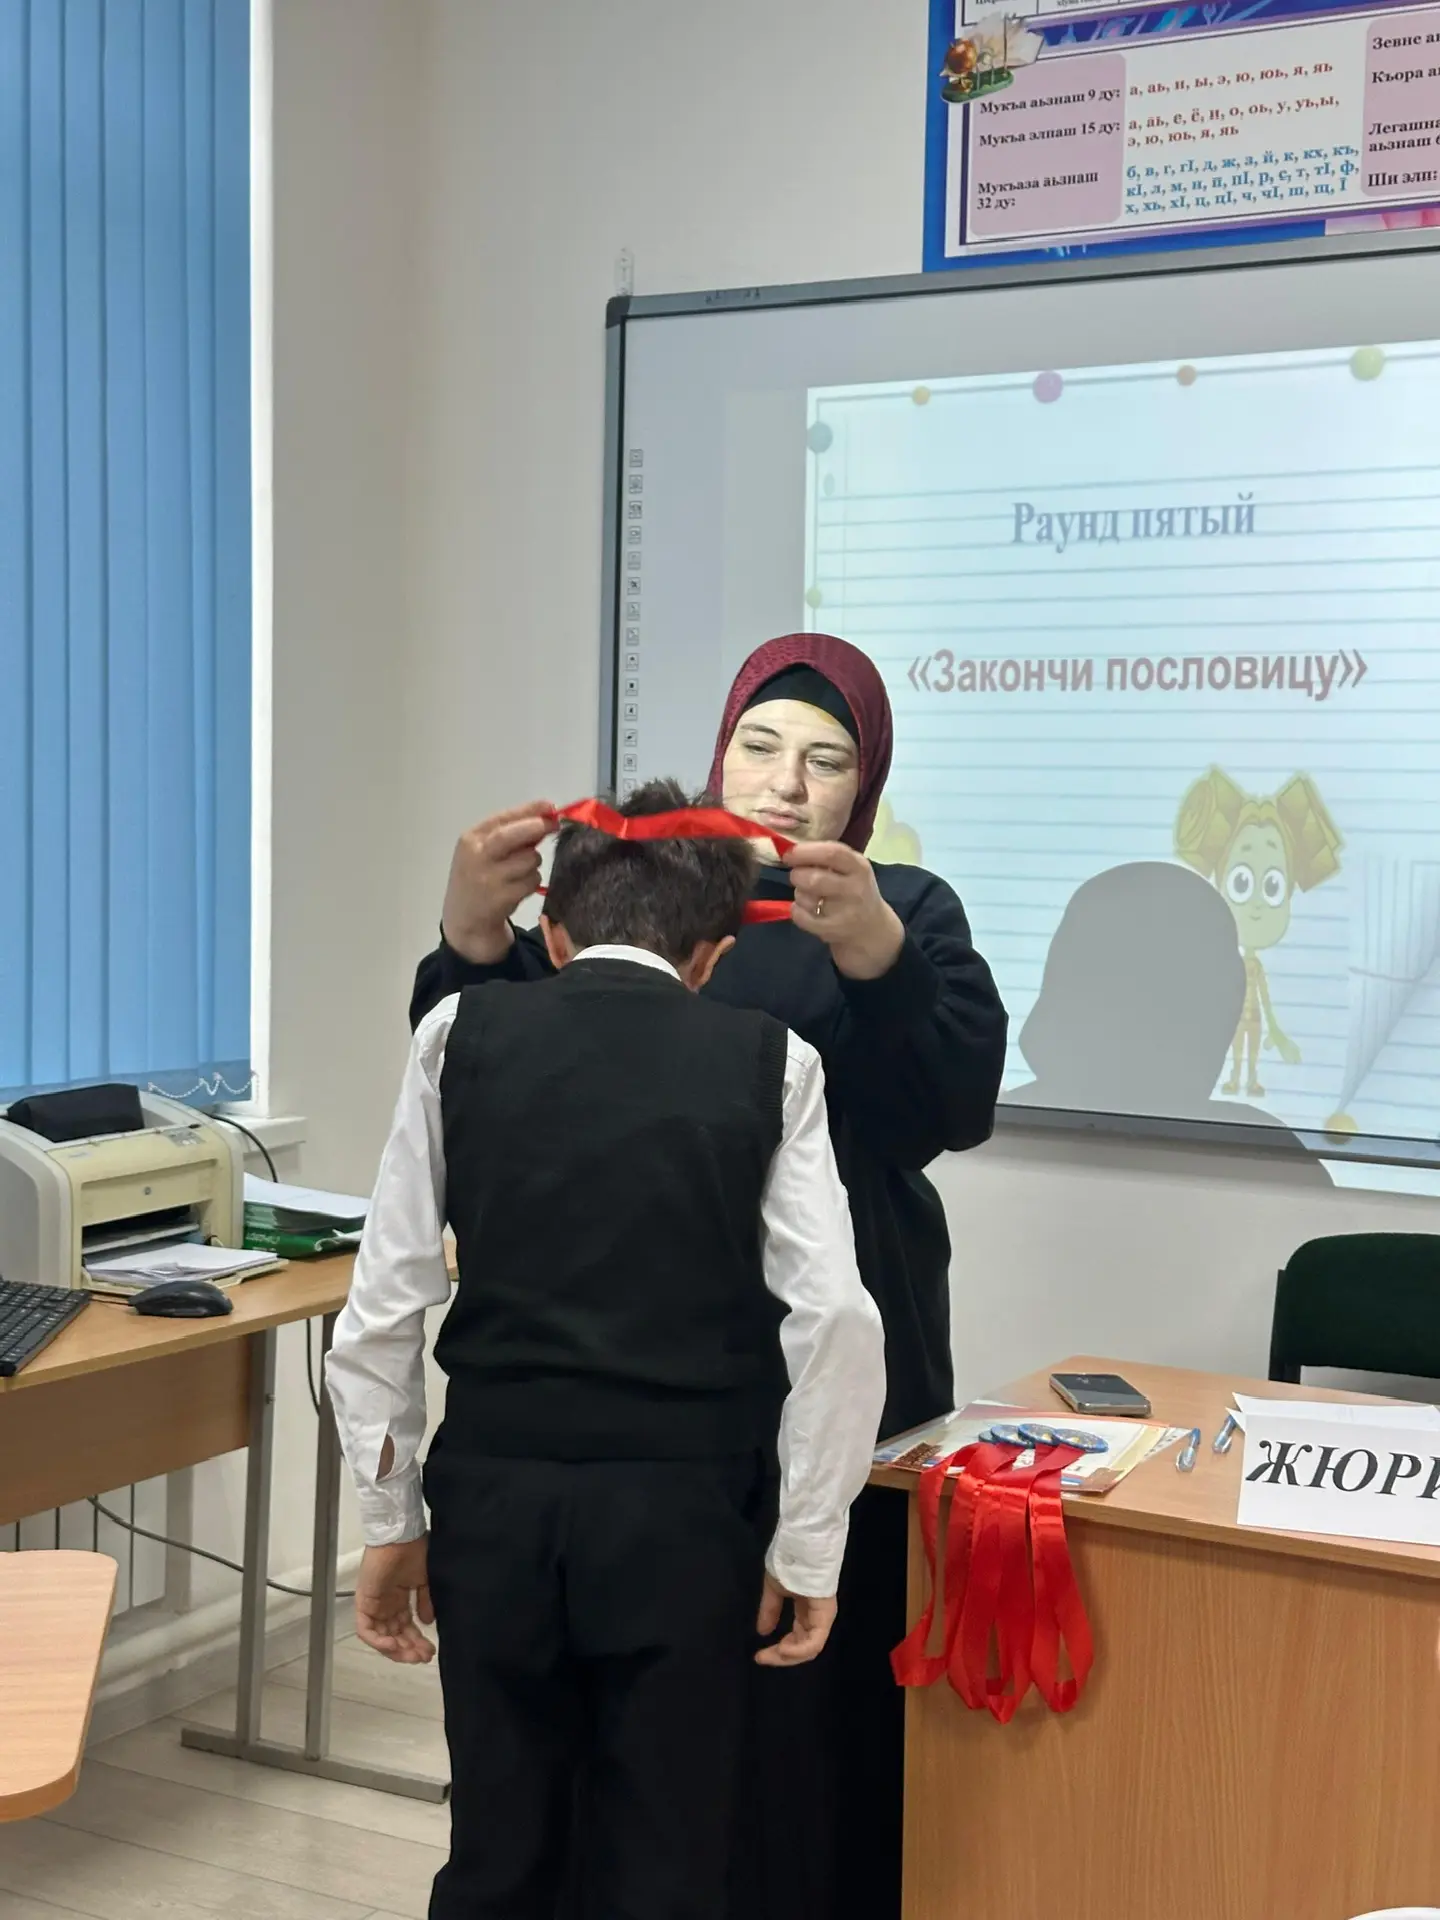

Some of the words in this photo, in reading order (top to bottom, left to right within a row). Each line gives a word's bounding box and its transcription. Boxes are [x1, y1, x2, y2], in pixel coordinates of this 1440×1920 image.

[1372, 35, 1422, 50] Зевне
[1372, 68, 1423, 83] Къора
[980, 100, 1027, 115] Мукъа
[1088, 89, 1096, 99] 9
[1099, 88, 1121, 101] ду:
[979, 133, 1026, 147] Мукъа
[1081, 122, 1096, 135] 15
[1098, 121, 1121, 134] ду:
[978, 179, 1040, 196] Мукъаза
[1368, 172, 1399, 187] Ши
[977, 197, 992, 210] 32
[994, 197, 1016, 210] ду:
[1012, 502, 1120, 554] Раунд
[1131, 492, 1256, 537] пятый
[906, 648, 1094, 693] «Закончи
[1106, 648, 1369, 702] пословицу»
